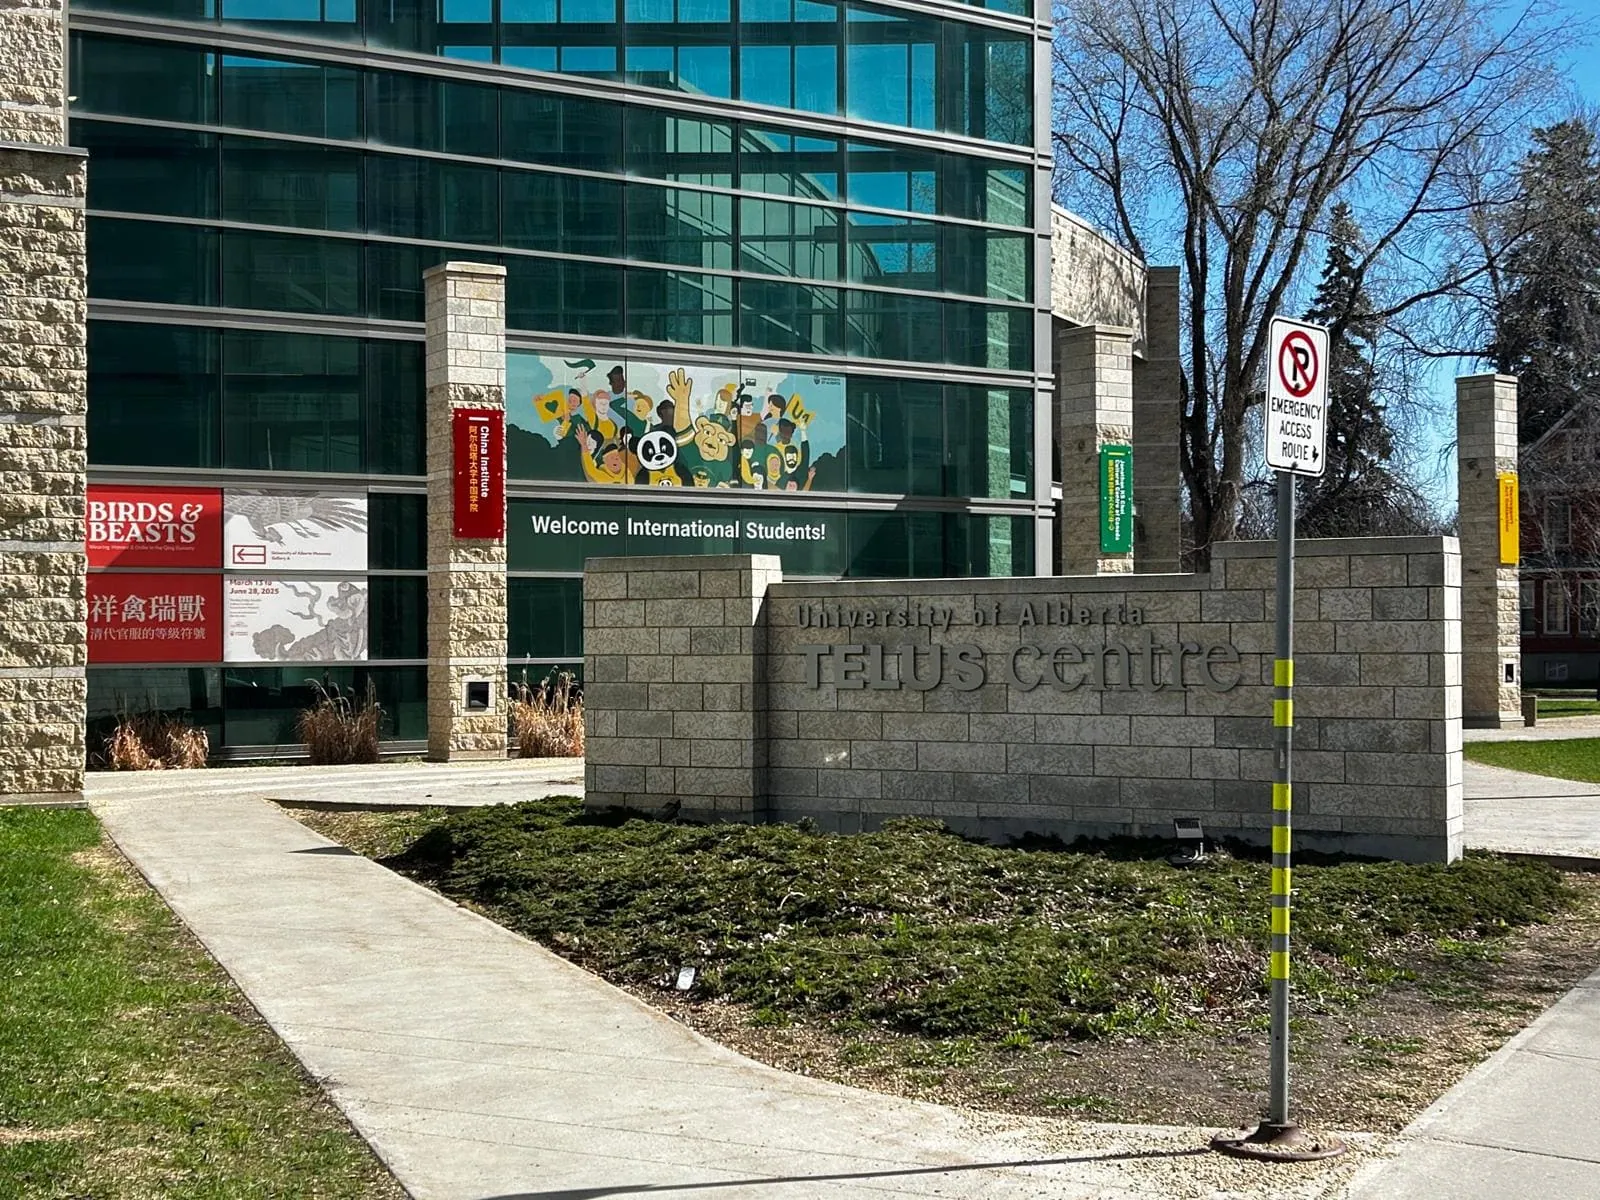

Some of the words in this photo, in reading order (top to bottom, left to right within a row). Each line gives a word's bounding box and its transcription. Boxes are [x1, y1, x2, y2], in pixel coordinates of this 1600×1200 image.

[1271, 397, 1322, 420] EMERGENCY
[480, 425, 489, 455] China
[1279, 420, 1312, 440] ACCESS
[1281, 441, 1309, 461] ROUTE
[480, 457, 490, 498] Institute
[88, 501, 175, 523] BIRDS
[180, 503, 204, 523] &
[88, 522, 196, 543] BEASTS
[531, 515, 620, 535] Welcome
[627, 517, 740, 538] International
[746, 521, 826, 541] Students!
[229, 587, 247, 595] June
[261, 587, 280, 595] 2025
[90, 594, 206, 623] 祥禽瑞獸
[797, 604, 954, 632] University
[972, 603, 1001, 628] of
[1018, 602, 1145, 627] Alberta
[800, 645, 988, 693] TELUS
[1006, 631, 1242, 693] centre
